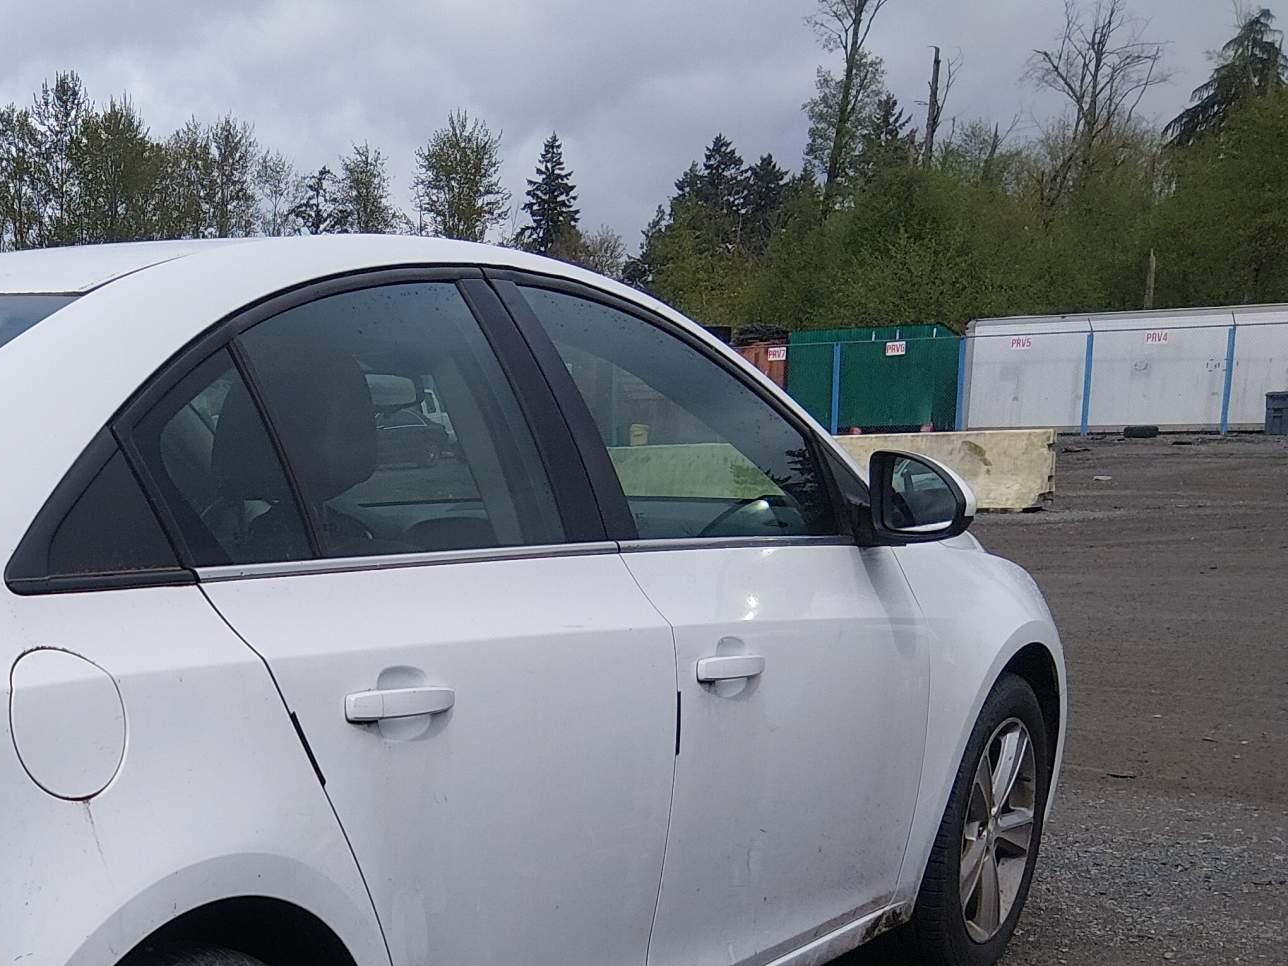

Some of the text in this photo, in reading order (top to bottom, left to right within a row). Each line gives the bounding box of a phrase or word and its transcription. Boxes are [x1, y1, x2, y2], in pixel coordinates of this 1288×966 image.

[1011, 337, 1032, 348] PRV5
[1146, 332, 1168, 342] PRV4
[768, 348, 785, 359] PRV7
